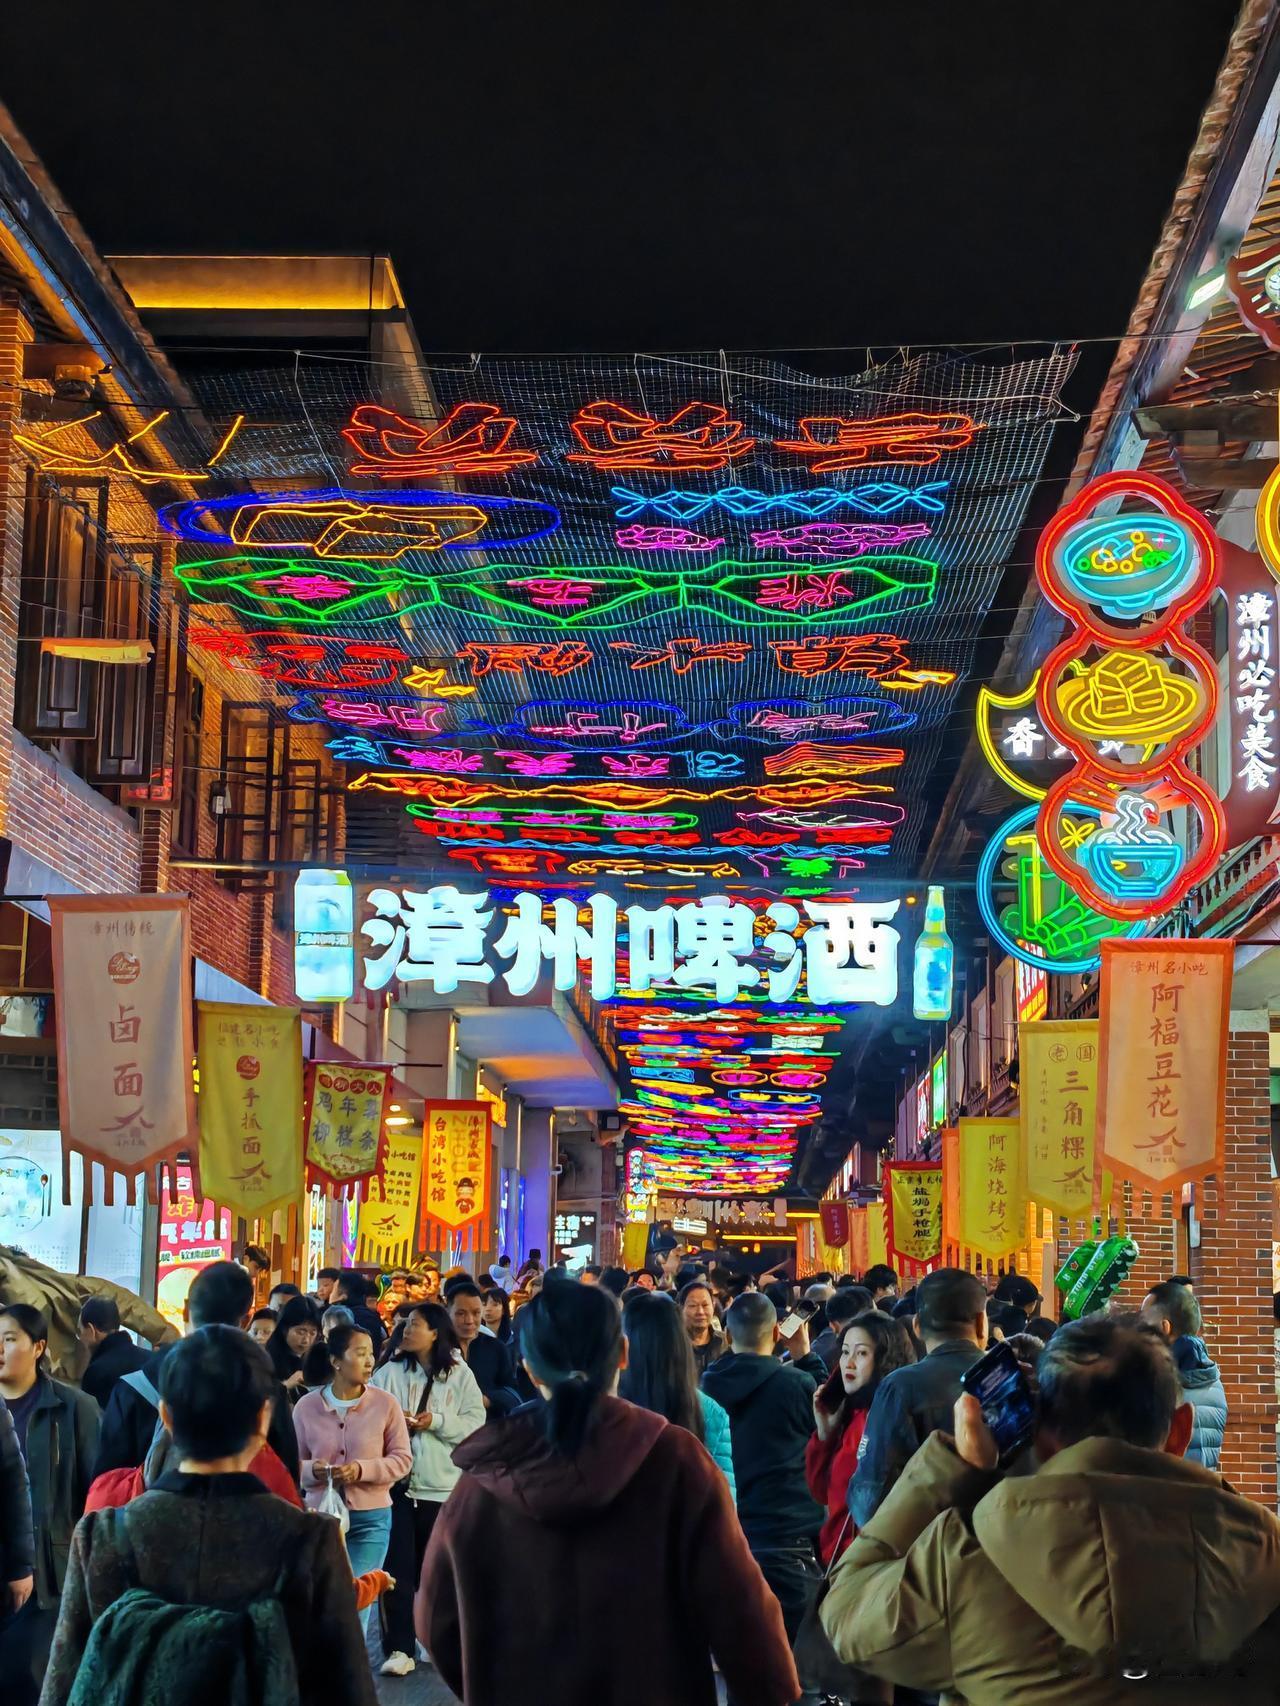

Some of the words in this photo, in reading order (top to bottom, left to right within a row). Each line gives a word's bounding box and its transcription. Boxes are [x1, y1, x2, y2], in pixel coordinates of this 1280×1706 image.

[1236, 592, 1277, 792] 漳州必吃美食
[363, 886, 901, 1006] 漳州啤酒
[109, 1004, 143, 1097] 卤面
[1147, 983, 1184, 1118] 阿福豆花
[431, 1117, 447, 1202] 台湾小吃馆
[1059, 1070, 1088, 1160] 三角粿
[988, 1134, 1007, 1219] 阿海烧烤
